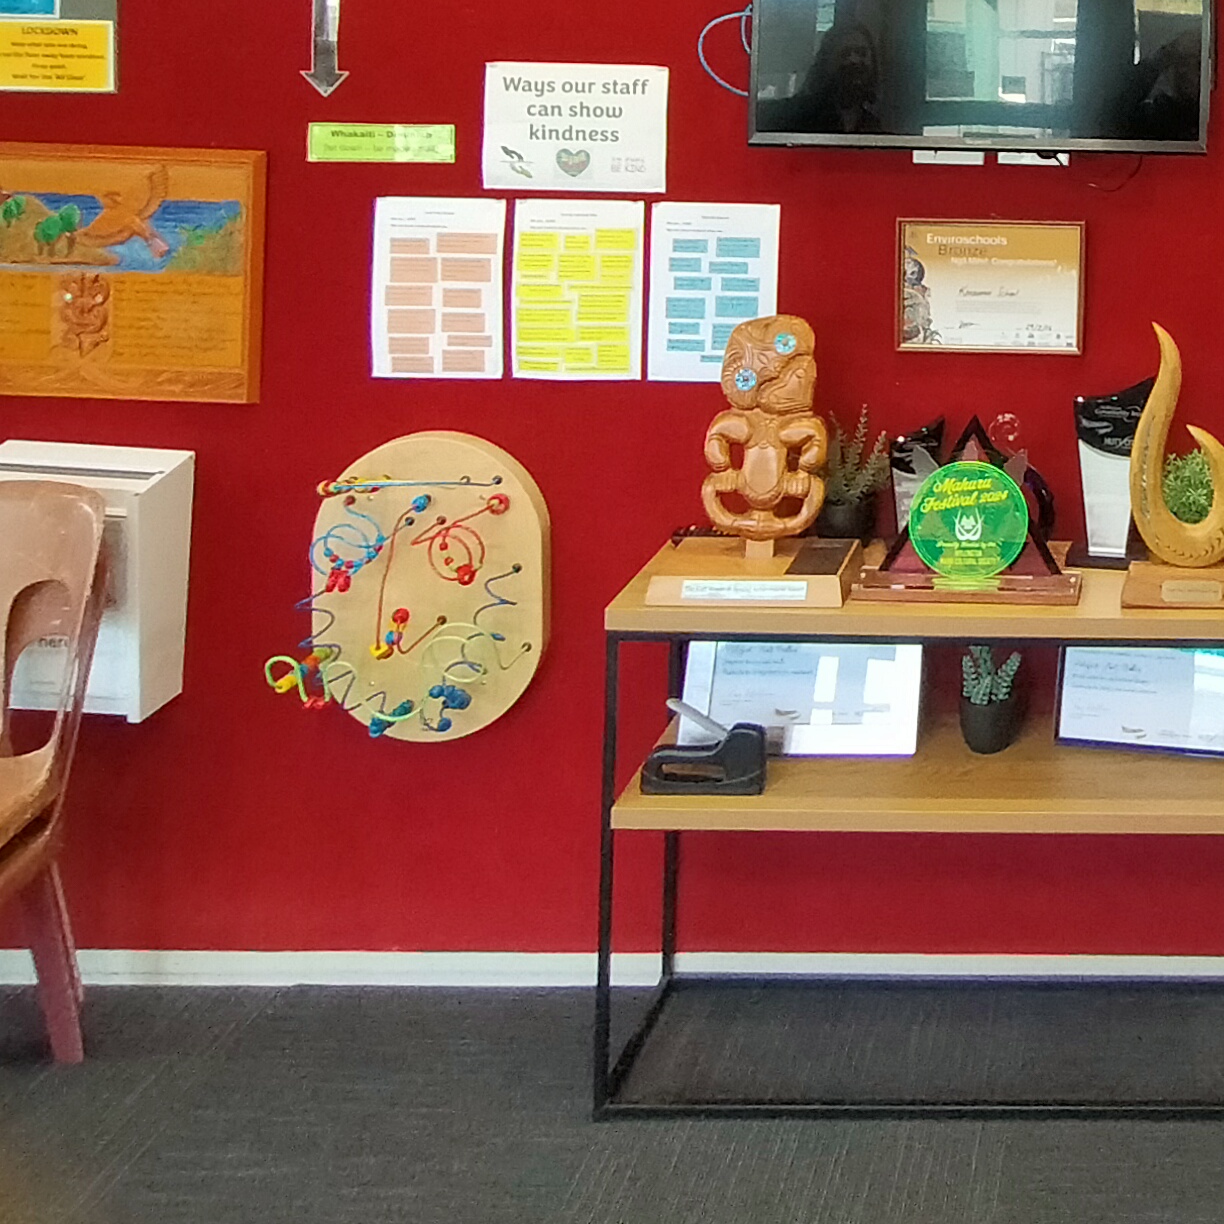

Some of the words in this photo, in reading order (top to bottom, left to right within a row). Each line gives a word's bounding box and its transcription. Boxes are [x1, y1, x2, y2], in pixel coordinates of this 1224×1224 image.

[502, 76, 556, 97] Ways
[561, 80, 596, 94] our
[601, 78, 650, 95] staff
[526, 103, 563, 117] can
[568, 101, 623, 118] show
[529, 124, 620, 143] kindness
[926, 233, 1008, 246] Enviroschools
[938, 244, 988, 256] Bronze
[920, 490, 979, 513] Festival
